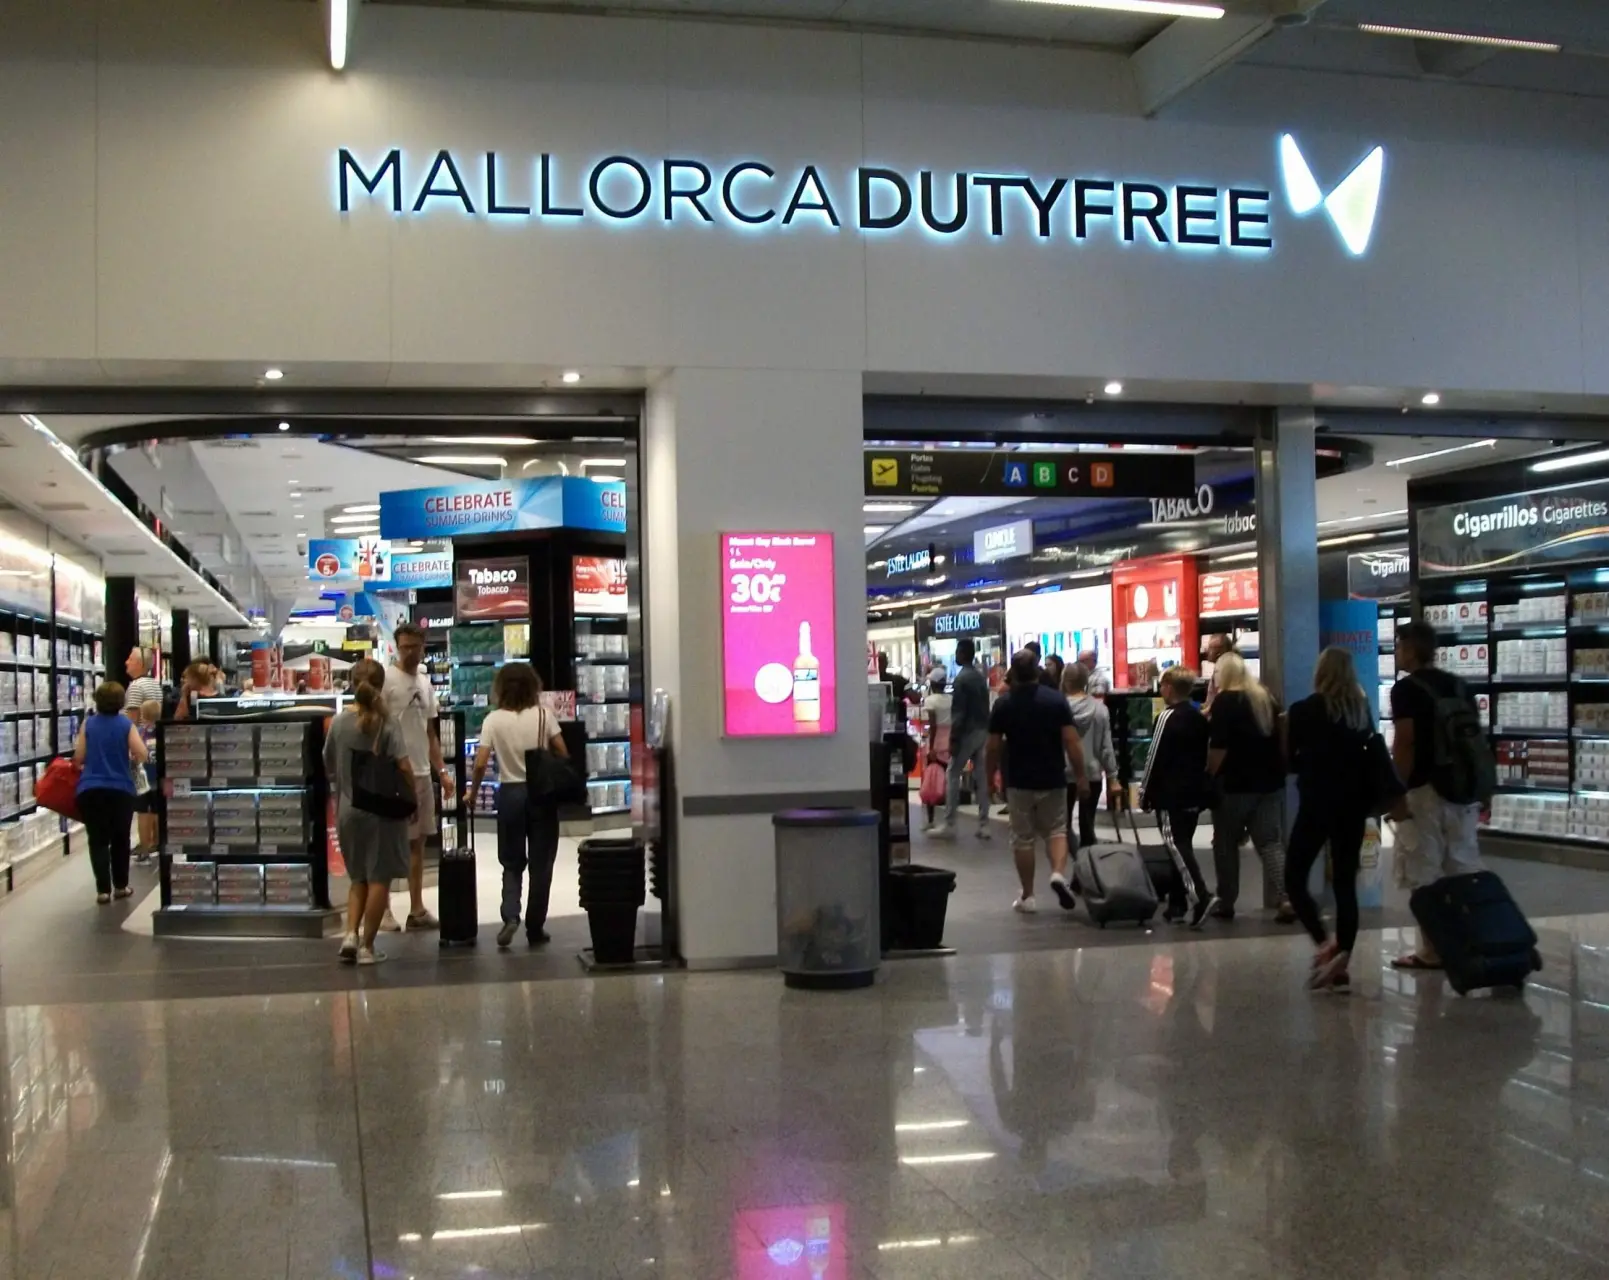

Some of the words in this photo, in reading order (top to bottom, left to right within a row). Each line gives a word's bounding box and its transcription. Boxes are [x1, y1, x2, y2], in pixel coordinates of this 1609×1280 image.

[338, 148, 841, 227] MALLORCA
[857, 166, 1273, 249] DUTYFREE
[1010, 466, 1022, 483] A
[1039, 466, 1050, 483] B
[1068, 466, 1079, 483] C
[1096, 466, 1108, 483] D
[424, 490, 512, 514] CELEBRATE
[1149, 484, 1214, 524] TABACO
[425, 511, 471, 528] SUMMER
[474, 508, 513, 523] DRINKS
[1453, 504, 1538, 538] Cigarrillos
[1542, 501, 1608, 525] Cigarettes
[393, 560, 450, 573] CELEBRATE
[468, 567, 517, 585] Tabaco
[477, 585, 509, 596] Tobacco
